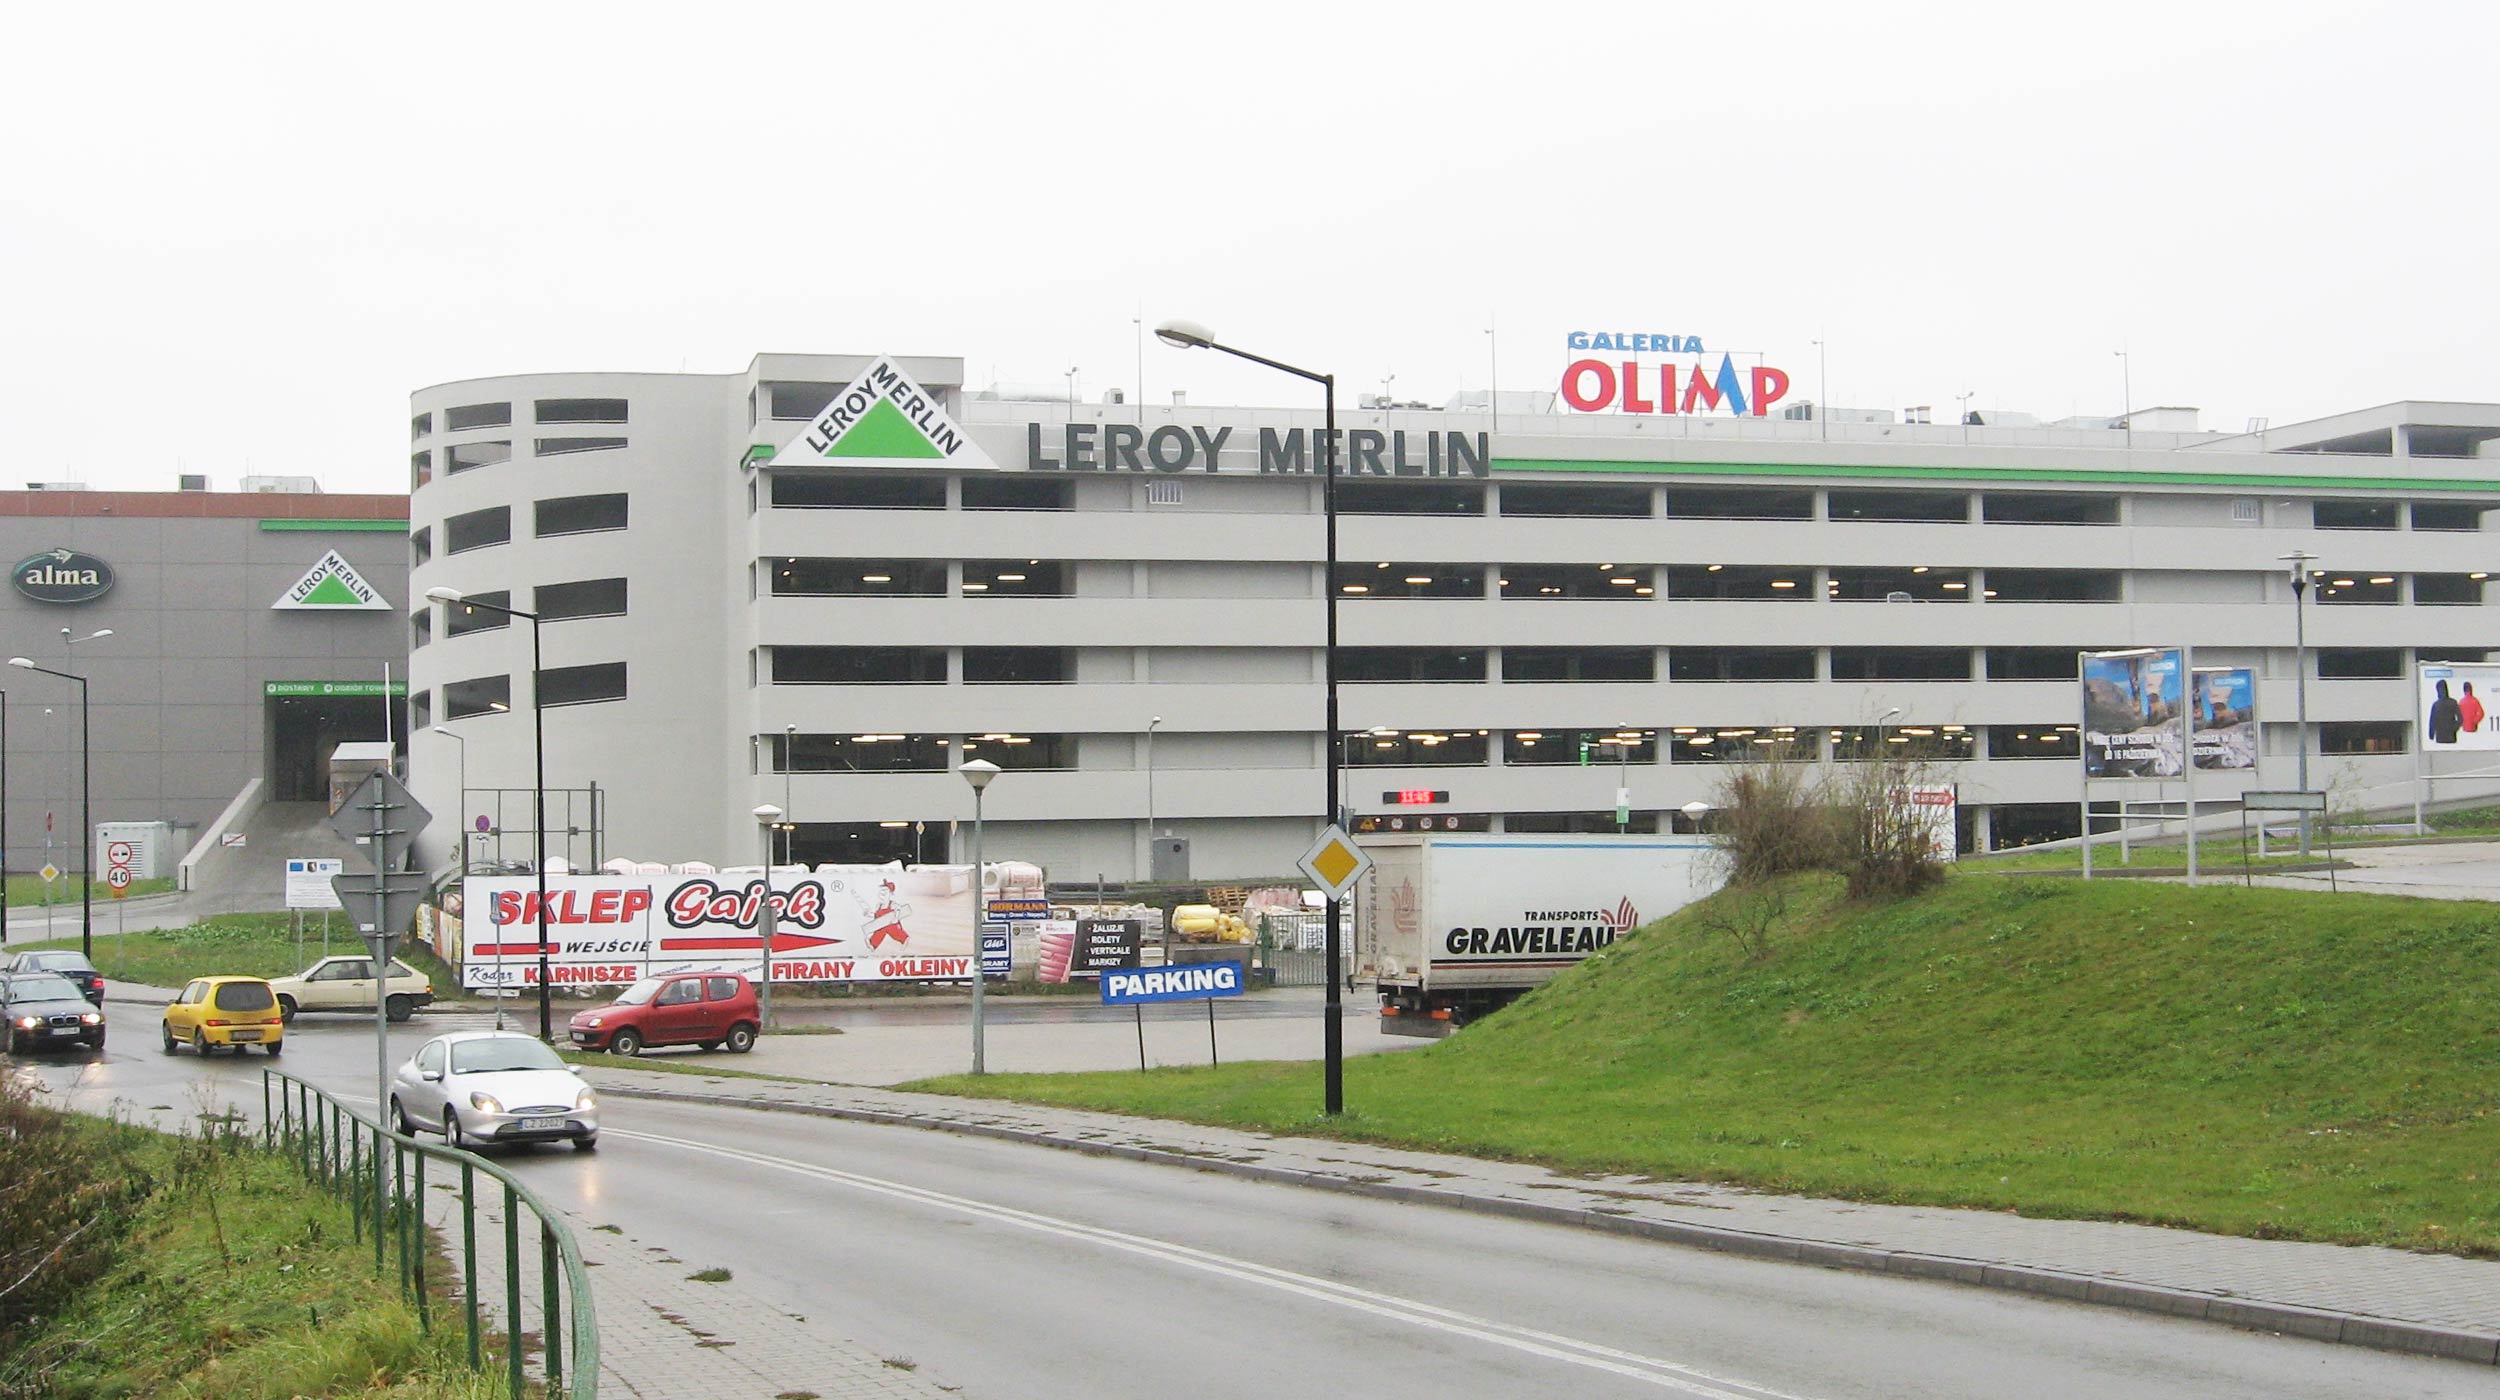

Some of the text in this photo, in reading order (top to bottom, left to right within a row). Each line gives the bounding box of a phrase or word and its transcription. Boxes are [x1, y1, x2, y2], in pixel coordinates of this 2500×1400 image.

[1567, 331, 1705, 353] GALERIA
[1561, 351, 1790, 417] OLIMP
[806, 362, 963, 456] LEROY MERLIN
[1027, 422, 1489, 477] LEROY MERLIN
[25, 565, 99, 585] alma
[290, 555, 374, 603] LEROY MERLIN
[110, 871, 128, 883] 40
[497, 881, 825, 929] SKLEP Gajek
[1524, 911, 1599, 921] TRANSPORTS
[566, 939, 653, 953] WEJŚCIE
[1090, 946, 1131, 955] VERTICALE
[1091, 936, 1121, 944] ROLETY
[1446, 927, 1615, 954] GRAVELEAU
[772, 961, 855, 980] FIRANY
[879, 959, 970, 977] OKLEINY
[1088, 958, 1122, 966] MARKIZY
[524, 966, 637, 983] KARNISZE
[1108, 967, 1236, 997] PARKING
